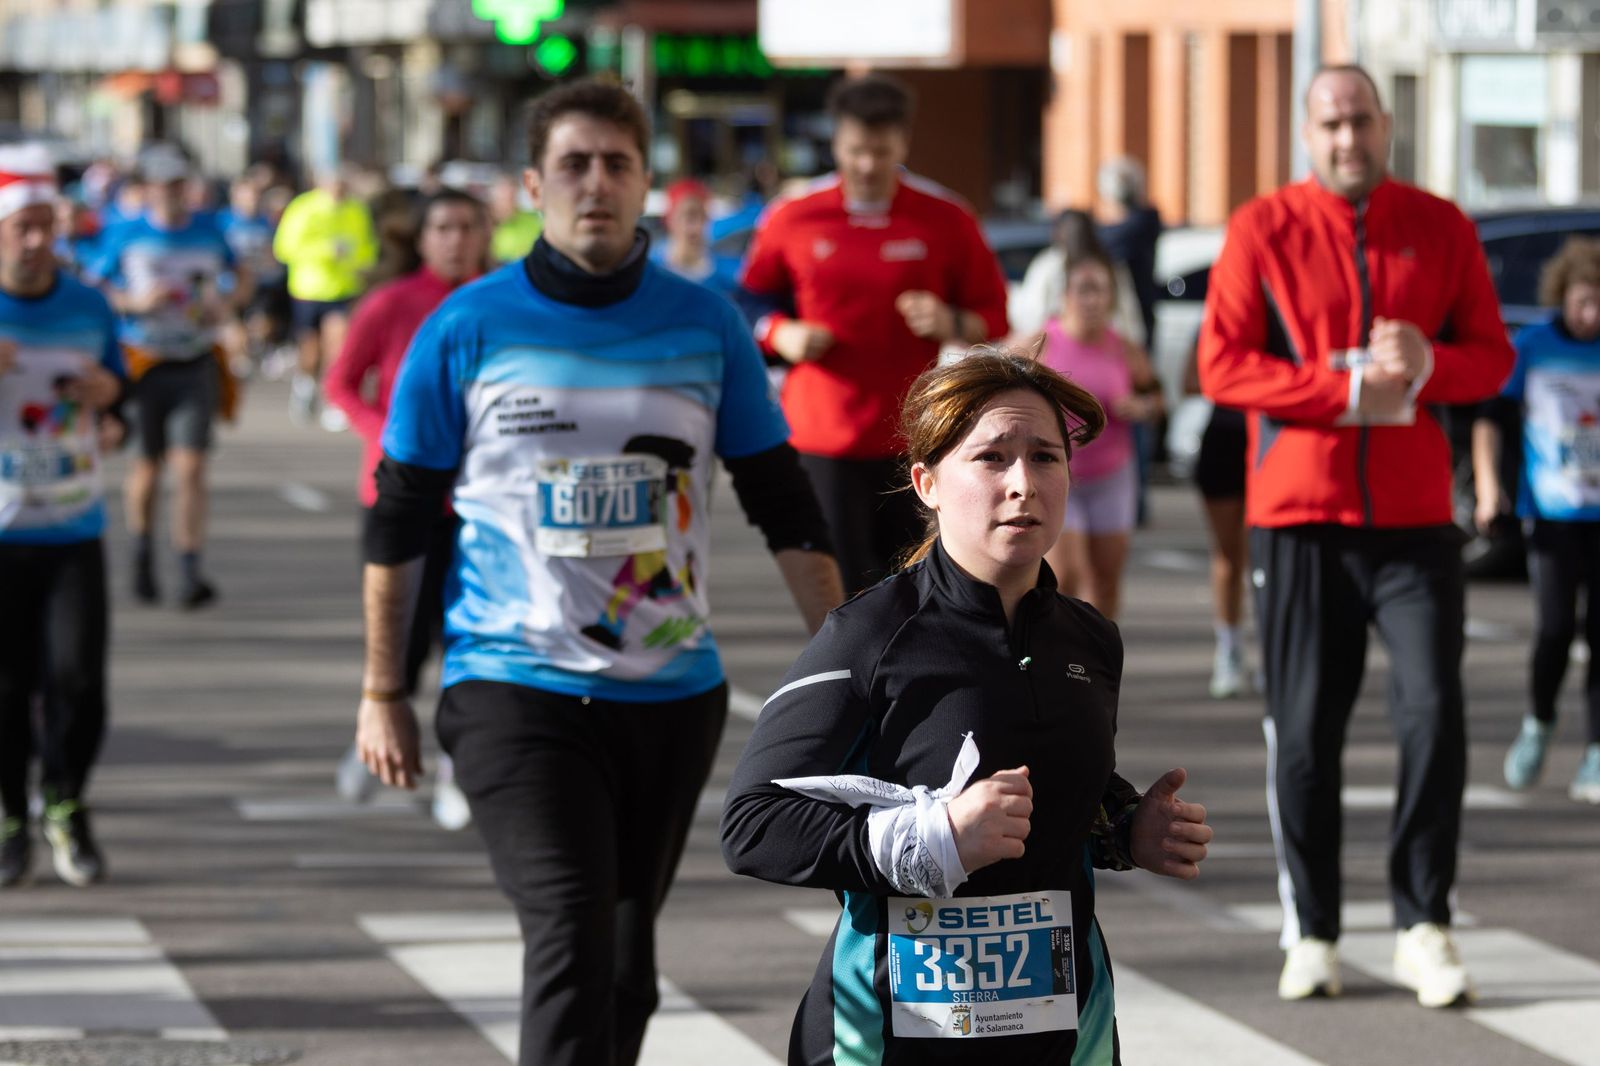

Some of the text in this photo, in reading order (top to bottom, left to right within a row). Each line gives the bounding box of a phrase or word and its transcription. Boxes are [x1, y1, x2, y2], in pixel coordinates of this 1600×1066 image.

[573, 461, 652, 480] SETEL
[551, 484, 637, 525] 6070
[938, 901, 1053, 929] SETEL
[1063, 933, 1071, 952] 3352
[914, 933, 1032, 991] 3352
[952, 991, 999, 1003] SIERRA
[975, 1012, 1023, 1023] Ayuntamiento
[975, 1023, 1024, 1033] de Salamanca
